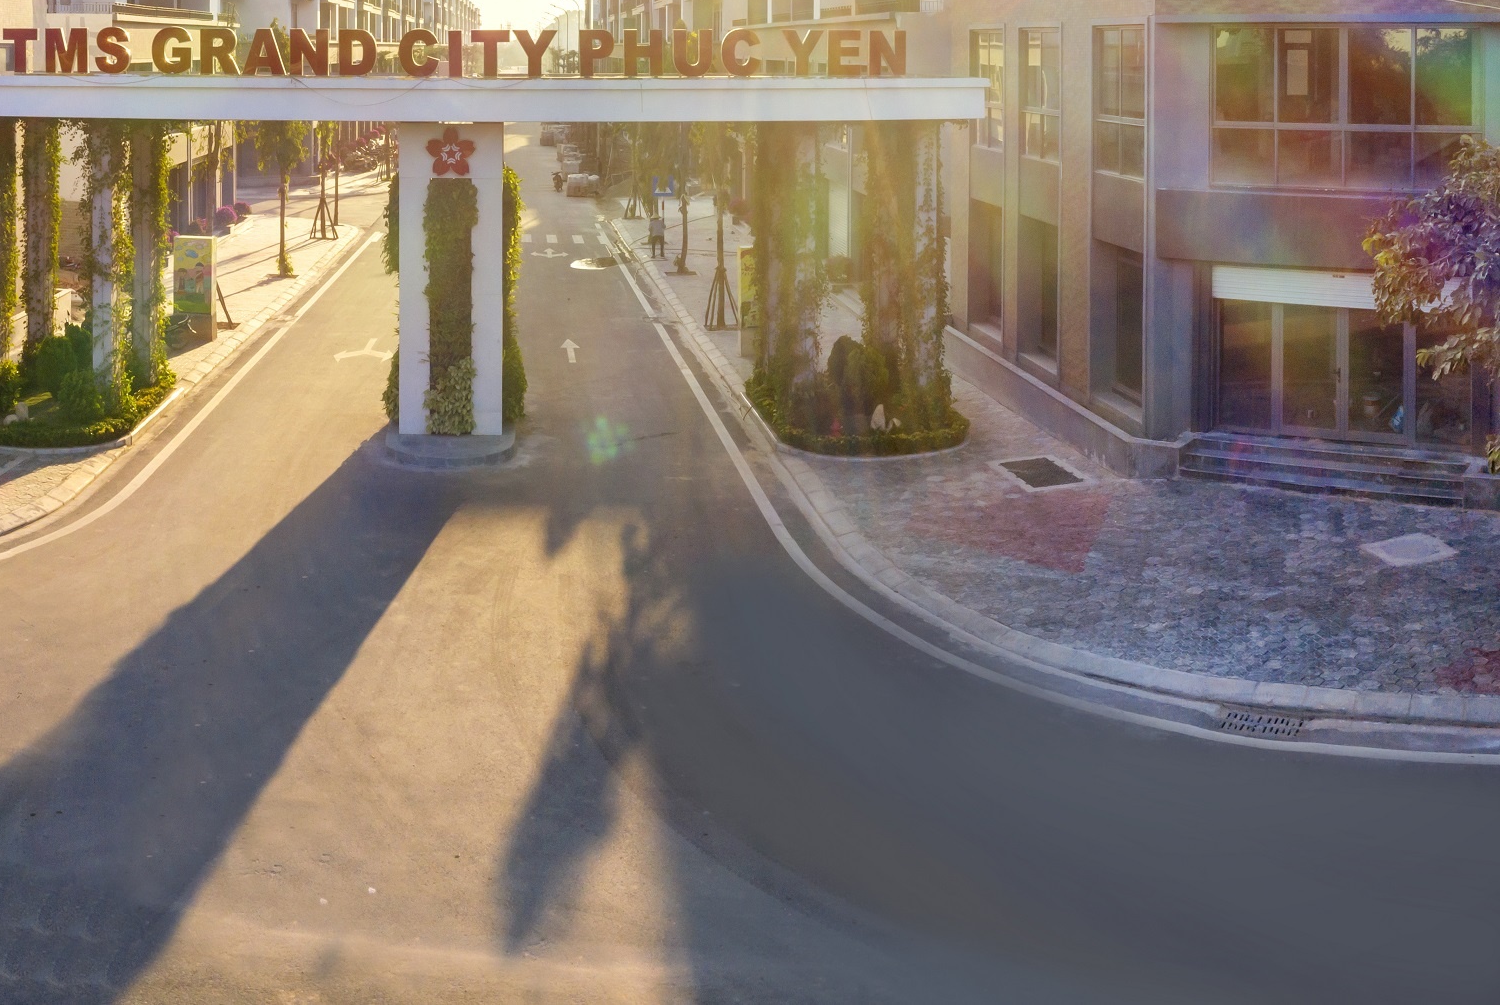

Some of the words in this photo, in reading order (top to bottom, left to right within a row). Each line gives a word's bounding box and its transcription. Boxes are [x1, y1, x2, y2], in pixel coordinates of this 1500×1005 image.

[3, 27, 132, 74] TMS
[151, 27, 377, 76] GRAND
[399, 28, 557, 78] CITY
[579, 28, 760, 77] PHUC
[781, 29, 907, 77] YEN
